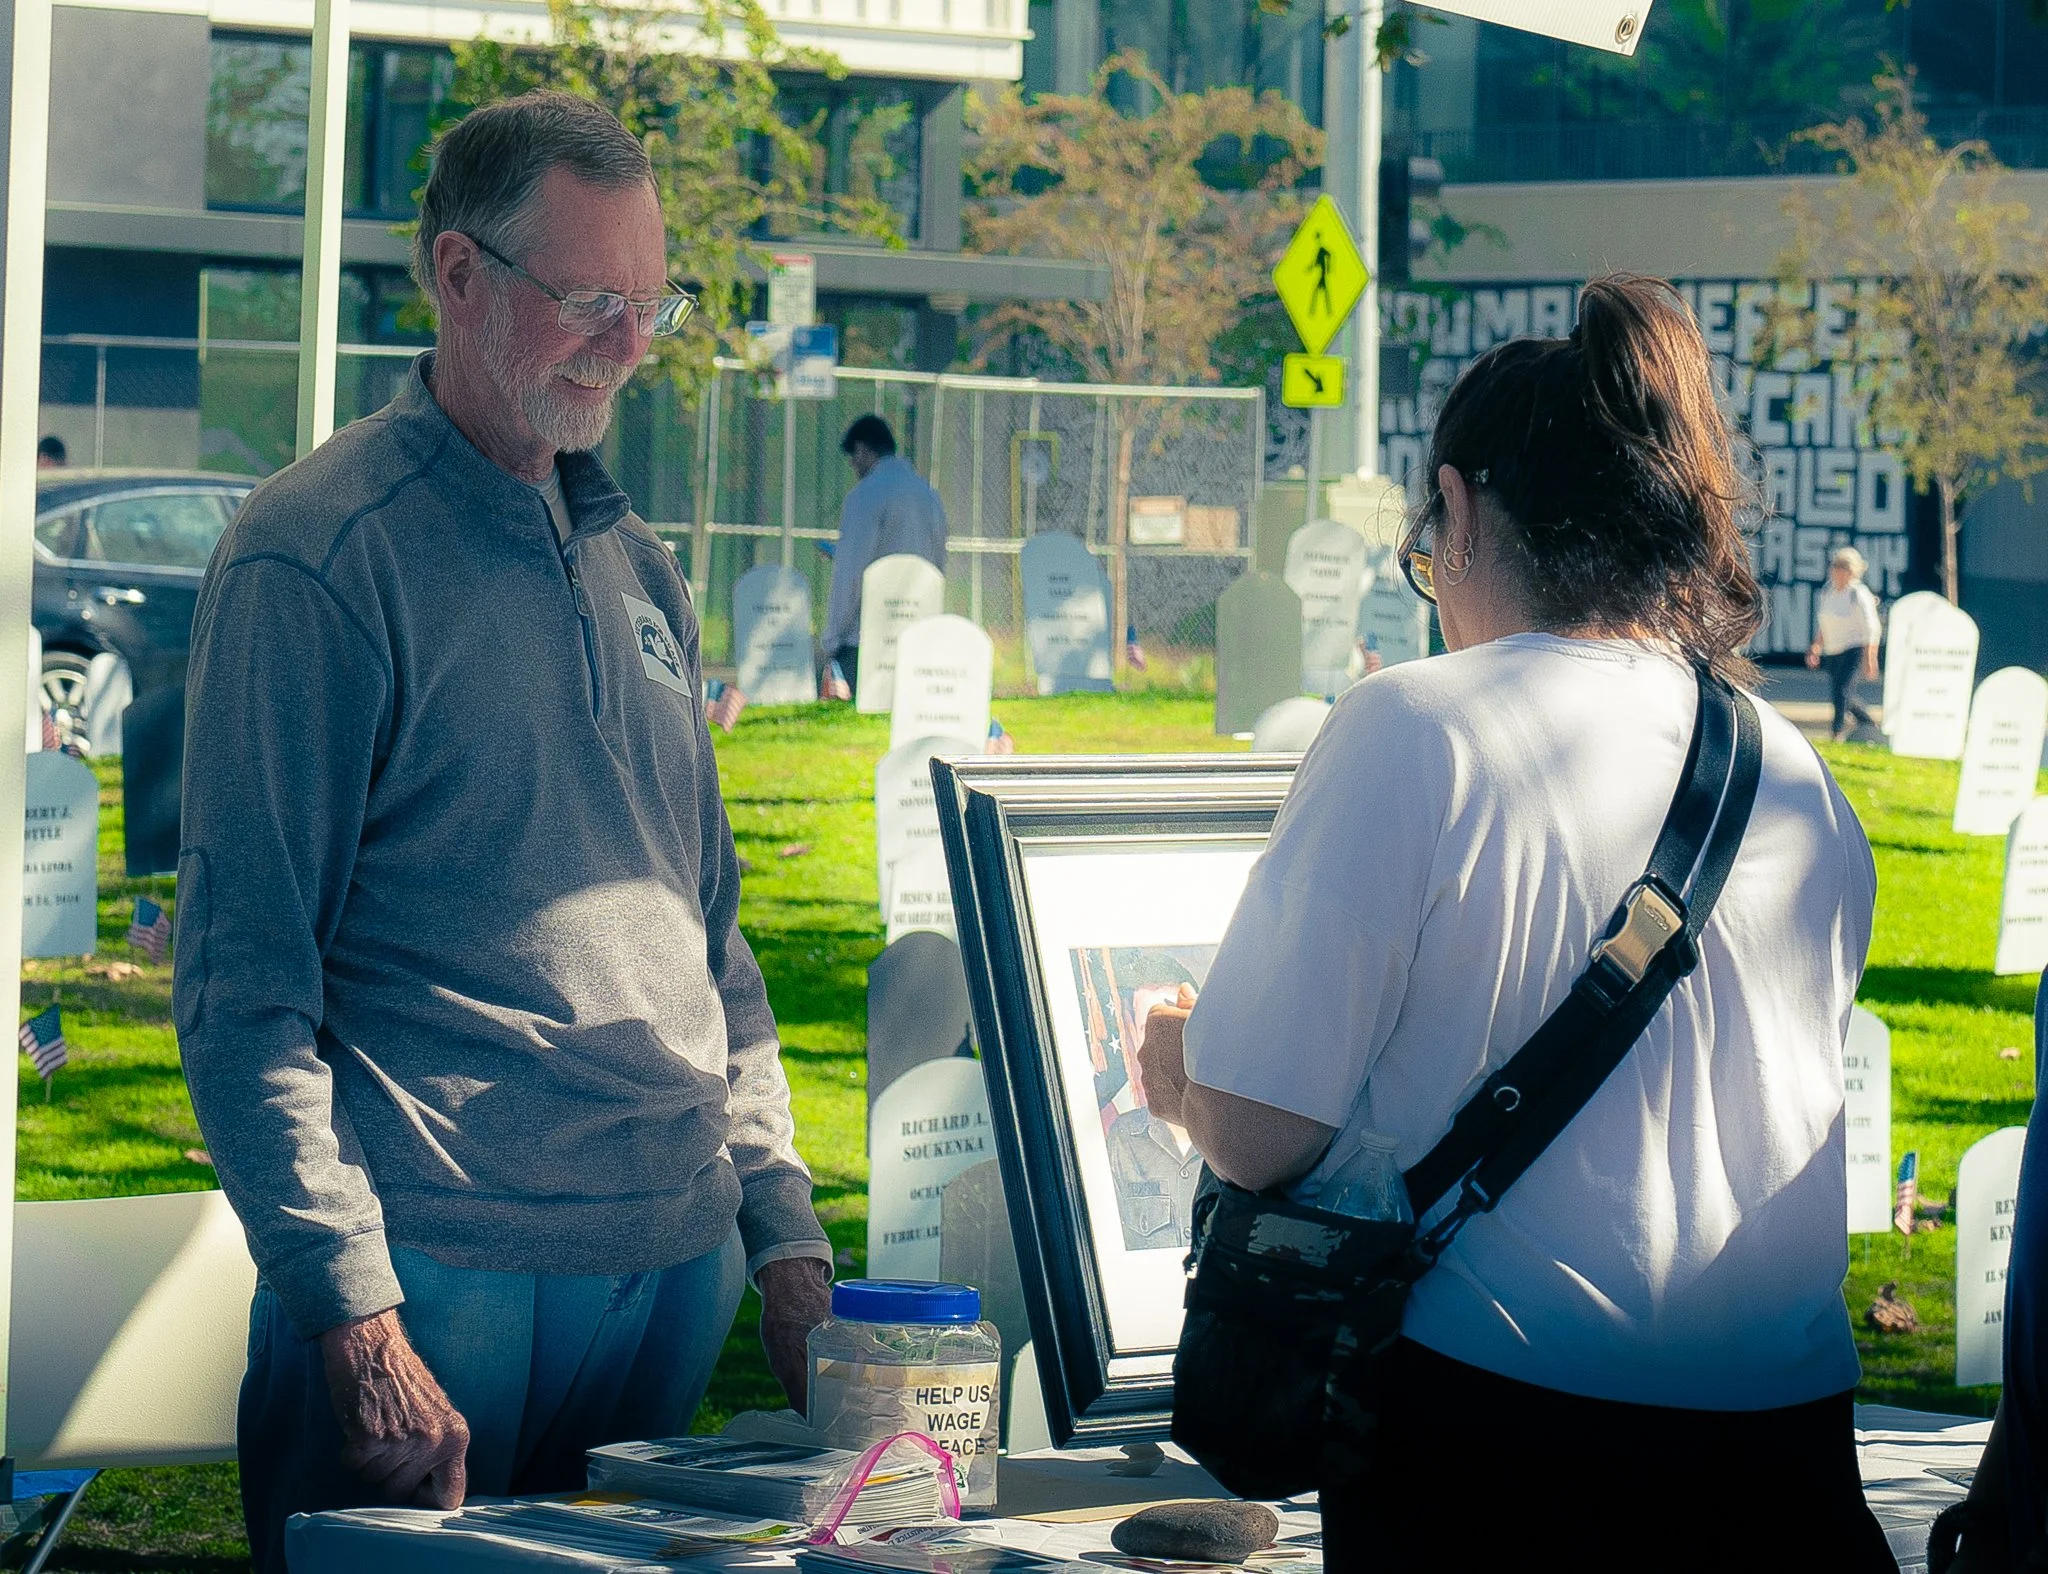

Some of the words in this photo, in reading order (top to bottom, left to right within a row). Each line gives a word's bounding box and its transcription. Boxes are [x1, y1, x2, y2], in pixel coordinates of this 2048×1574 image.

[901, 1114, 970, 1137] RICHARD
[916, 1386, 963, 1406] HELP
[968, 1385, 990, 1403] US
[927, 1412, 981, 1432] WAGE
